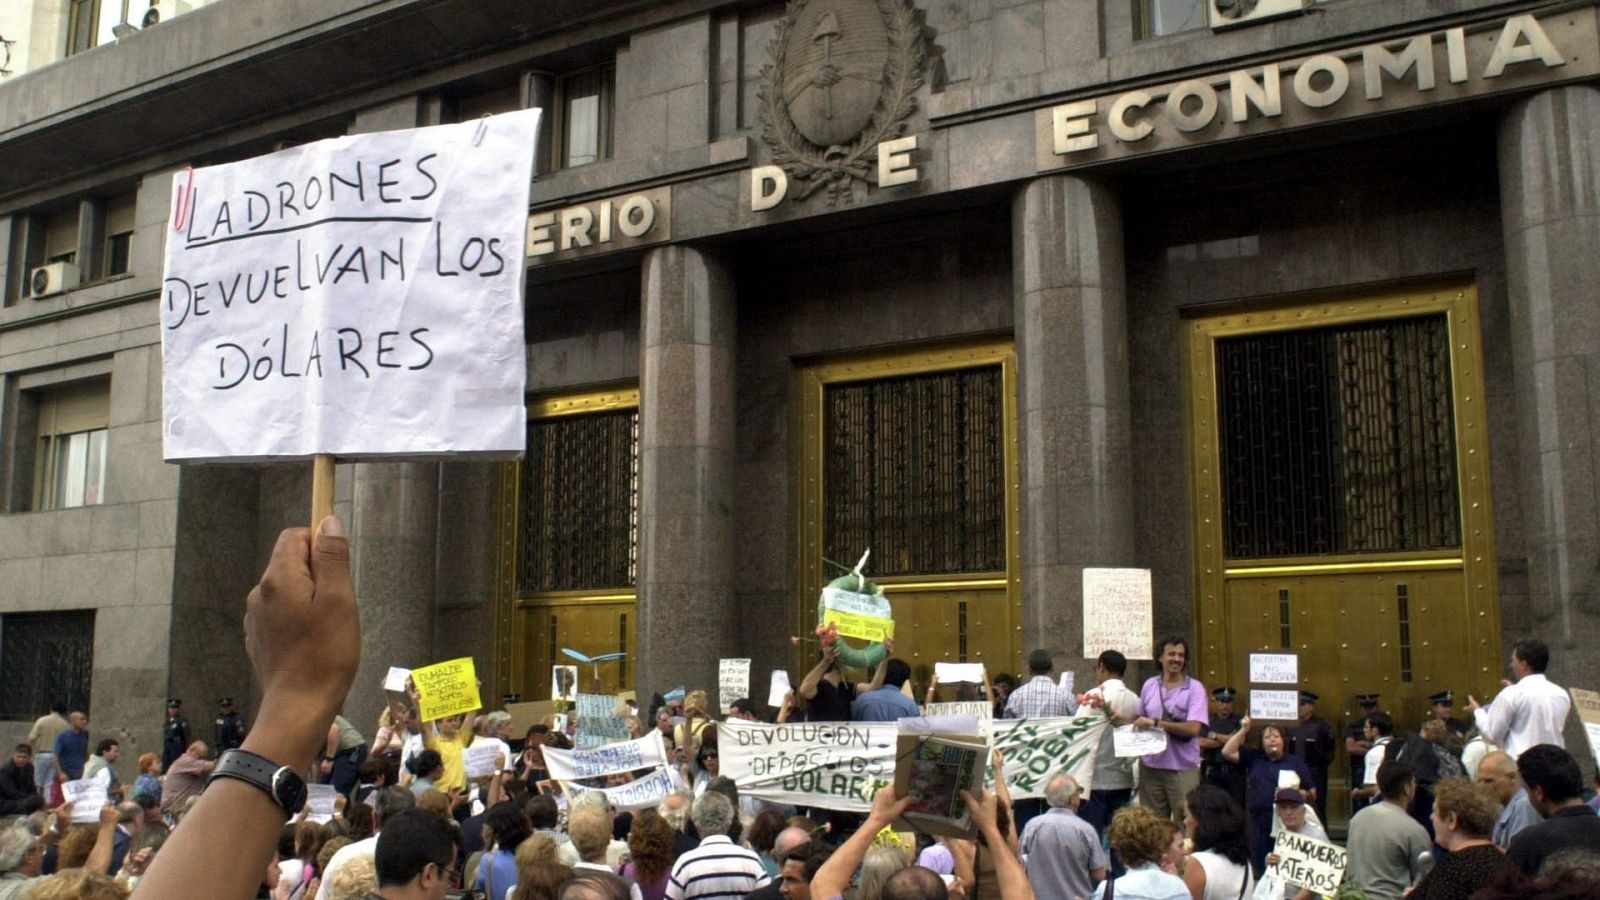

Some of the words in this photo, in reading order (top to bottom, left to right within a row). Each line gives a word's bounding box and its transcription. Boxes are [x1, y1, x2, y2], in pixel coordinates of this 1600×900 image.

[527, 195, 655, 257] ERIO
[1053, 14, 1566, 155] ECONOMIA
[186, 153, 438, 244] LADRONES
[163, 237, 405, 330] DEVUELVAN
[435, 220, 505, 278] LOS
[211, 322, 434, 390] DÓLARES
[1015, 716, 1098, 793] ROBAR
[1277, 831, 1348, 870] BANQUEROS
